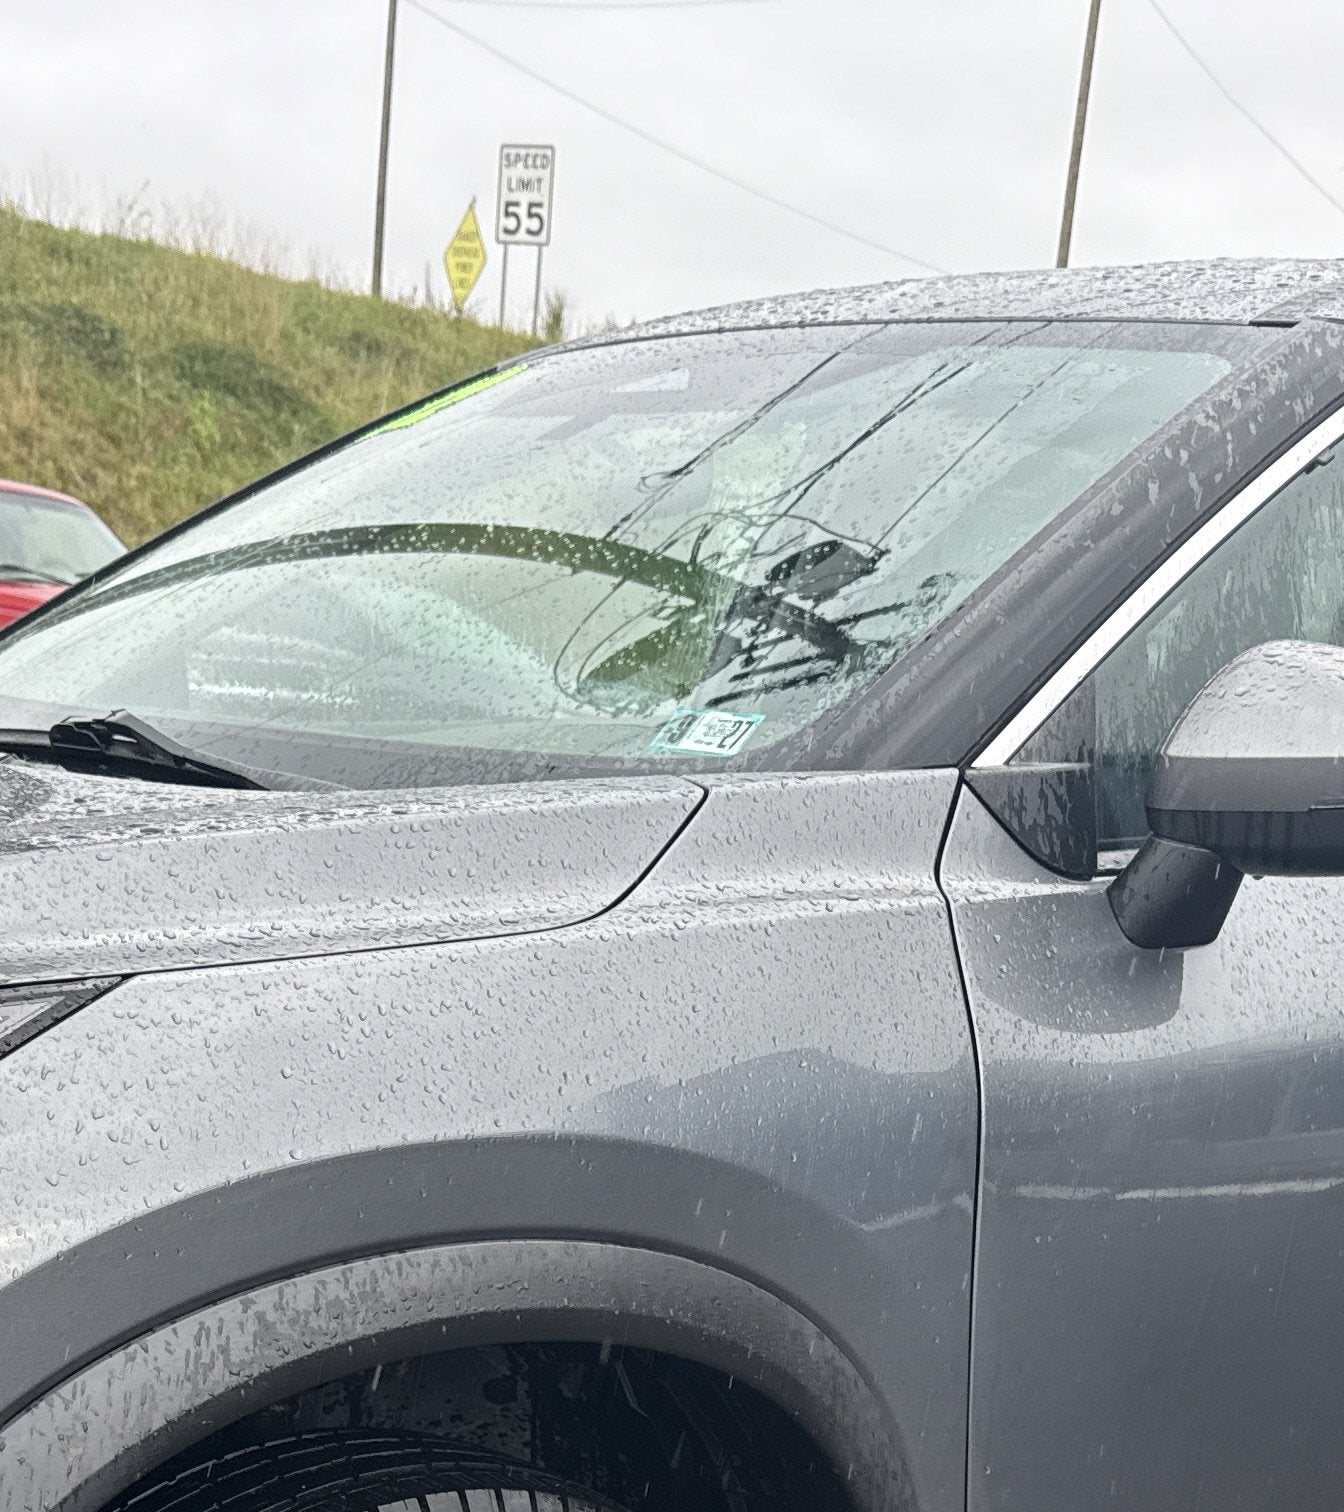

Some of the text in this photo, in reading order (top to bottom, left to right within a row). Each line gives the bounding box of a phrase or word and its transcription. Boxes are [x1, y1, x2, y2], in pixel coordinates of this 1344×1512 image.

[503, 152, 551, 170] SPEED
[507, 176, 545, 193] LIMIT
[503, 200, 545, 237] 55
